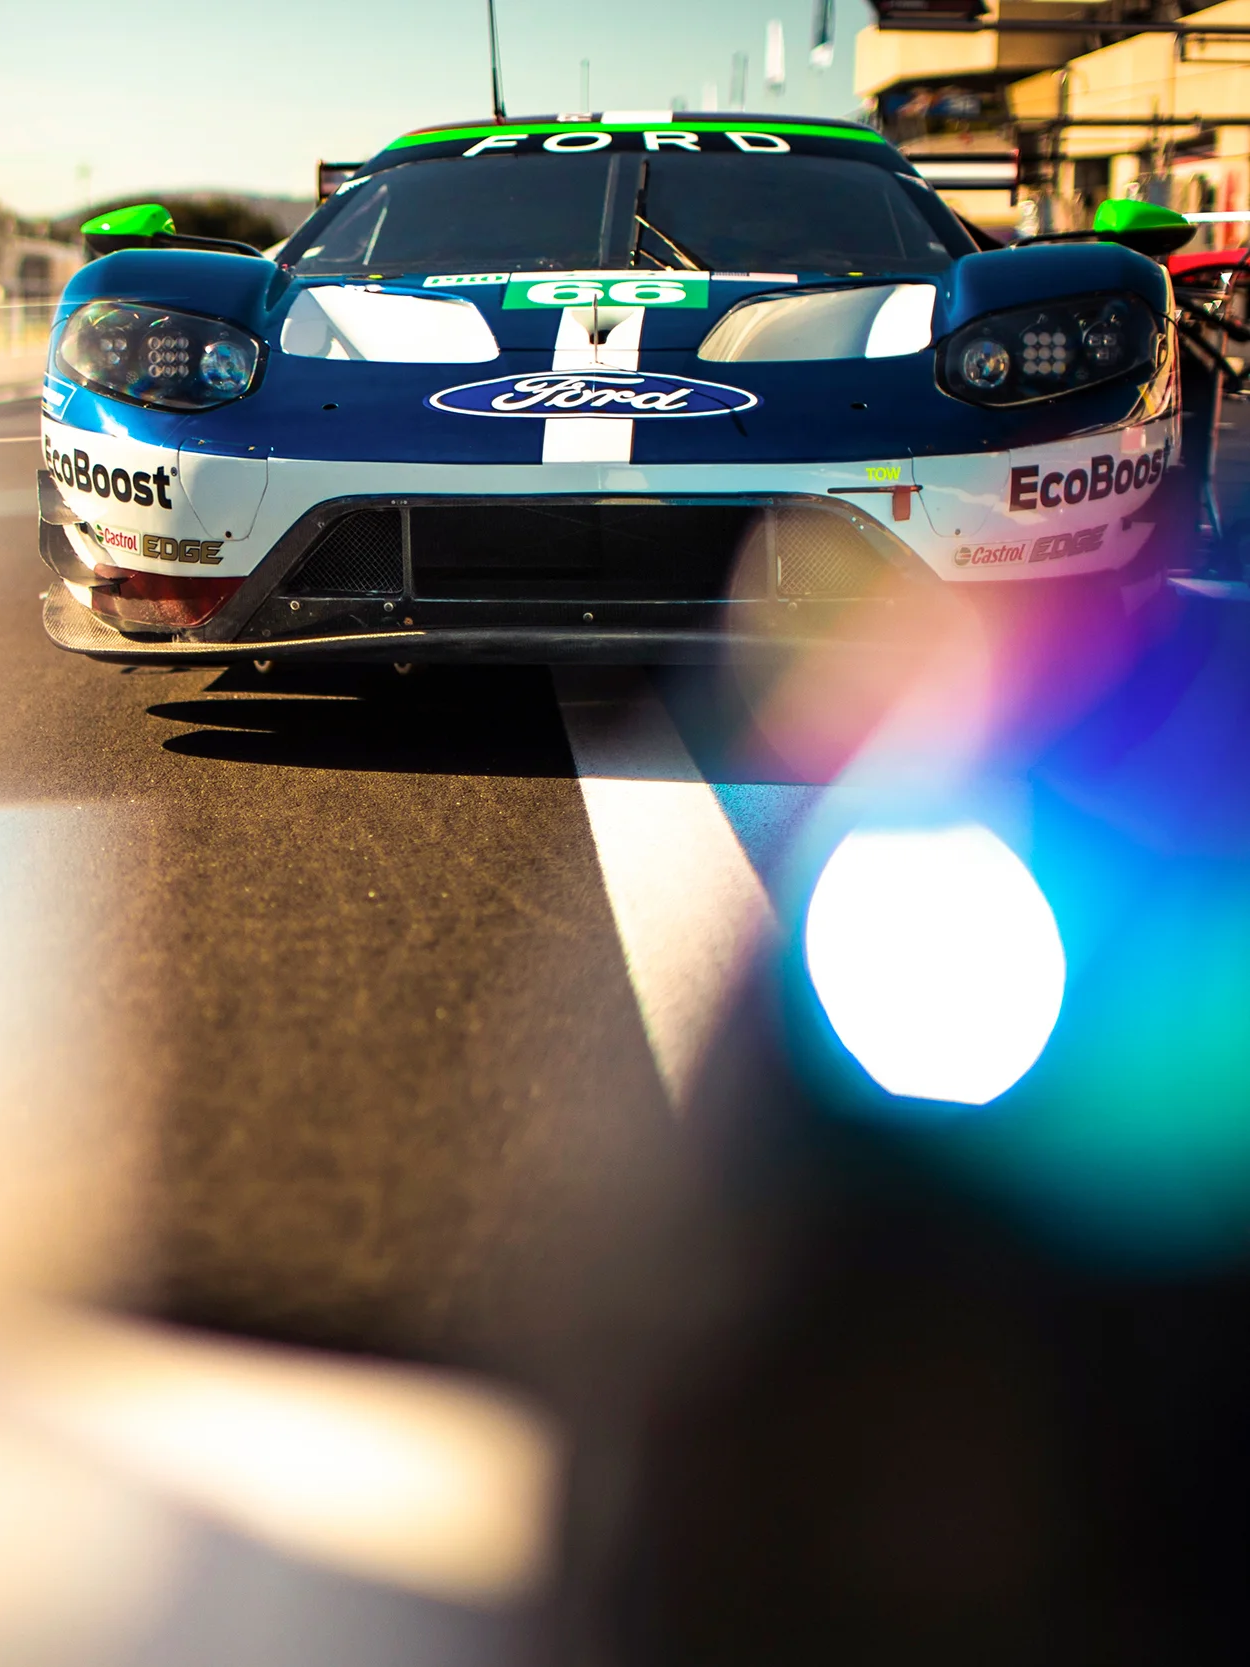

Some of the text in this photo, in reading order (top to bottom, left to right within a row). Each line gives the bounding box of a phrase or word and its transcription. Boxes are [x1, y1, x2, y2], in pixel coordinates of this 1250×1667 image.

[462, 131, 791, 157] FORD
[526, 281, 687, 304] 66
[491, 375, 694, 411] Ford
[865, 466, 901, 482] TOW
[104, 527, 225, 565] Castrol EDGE
[971, 524, 1110, 565] Castrol EDGE
